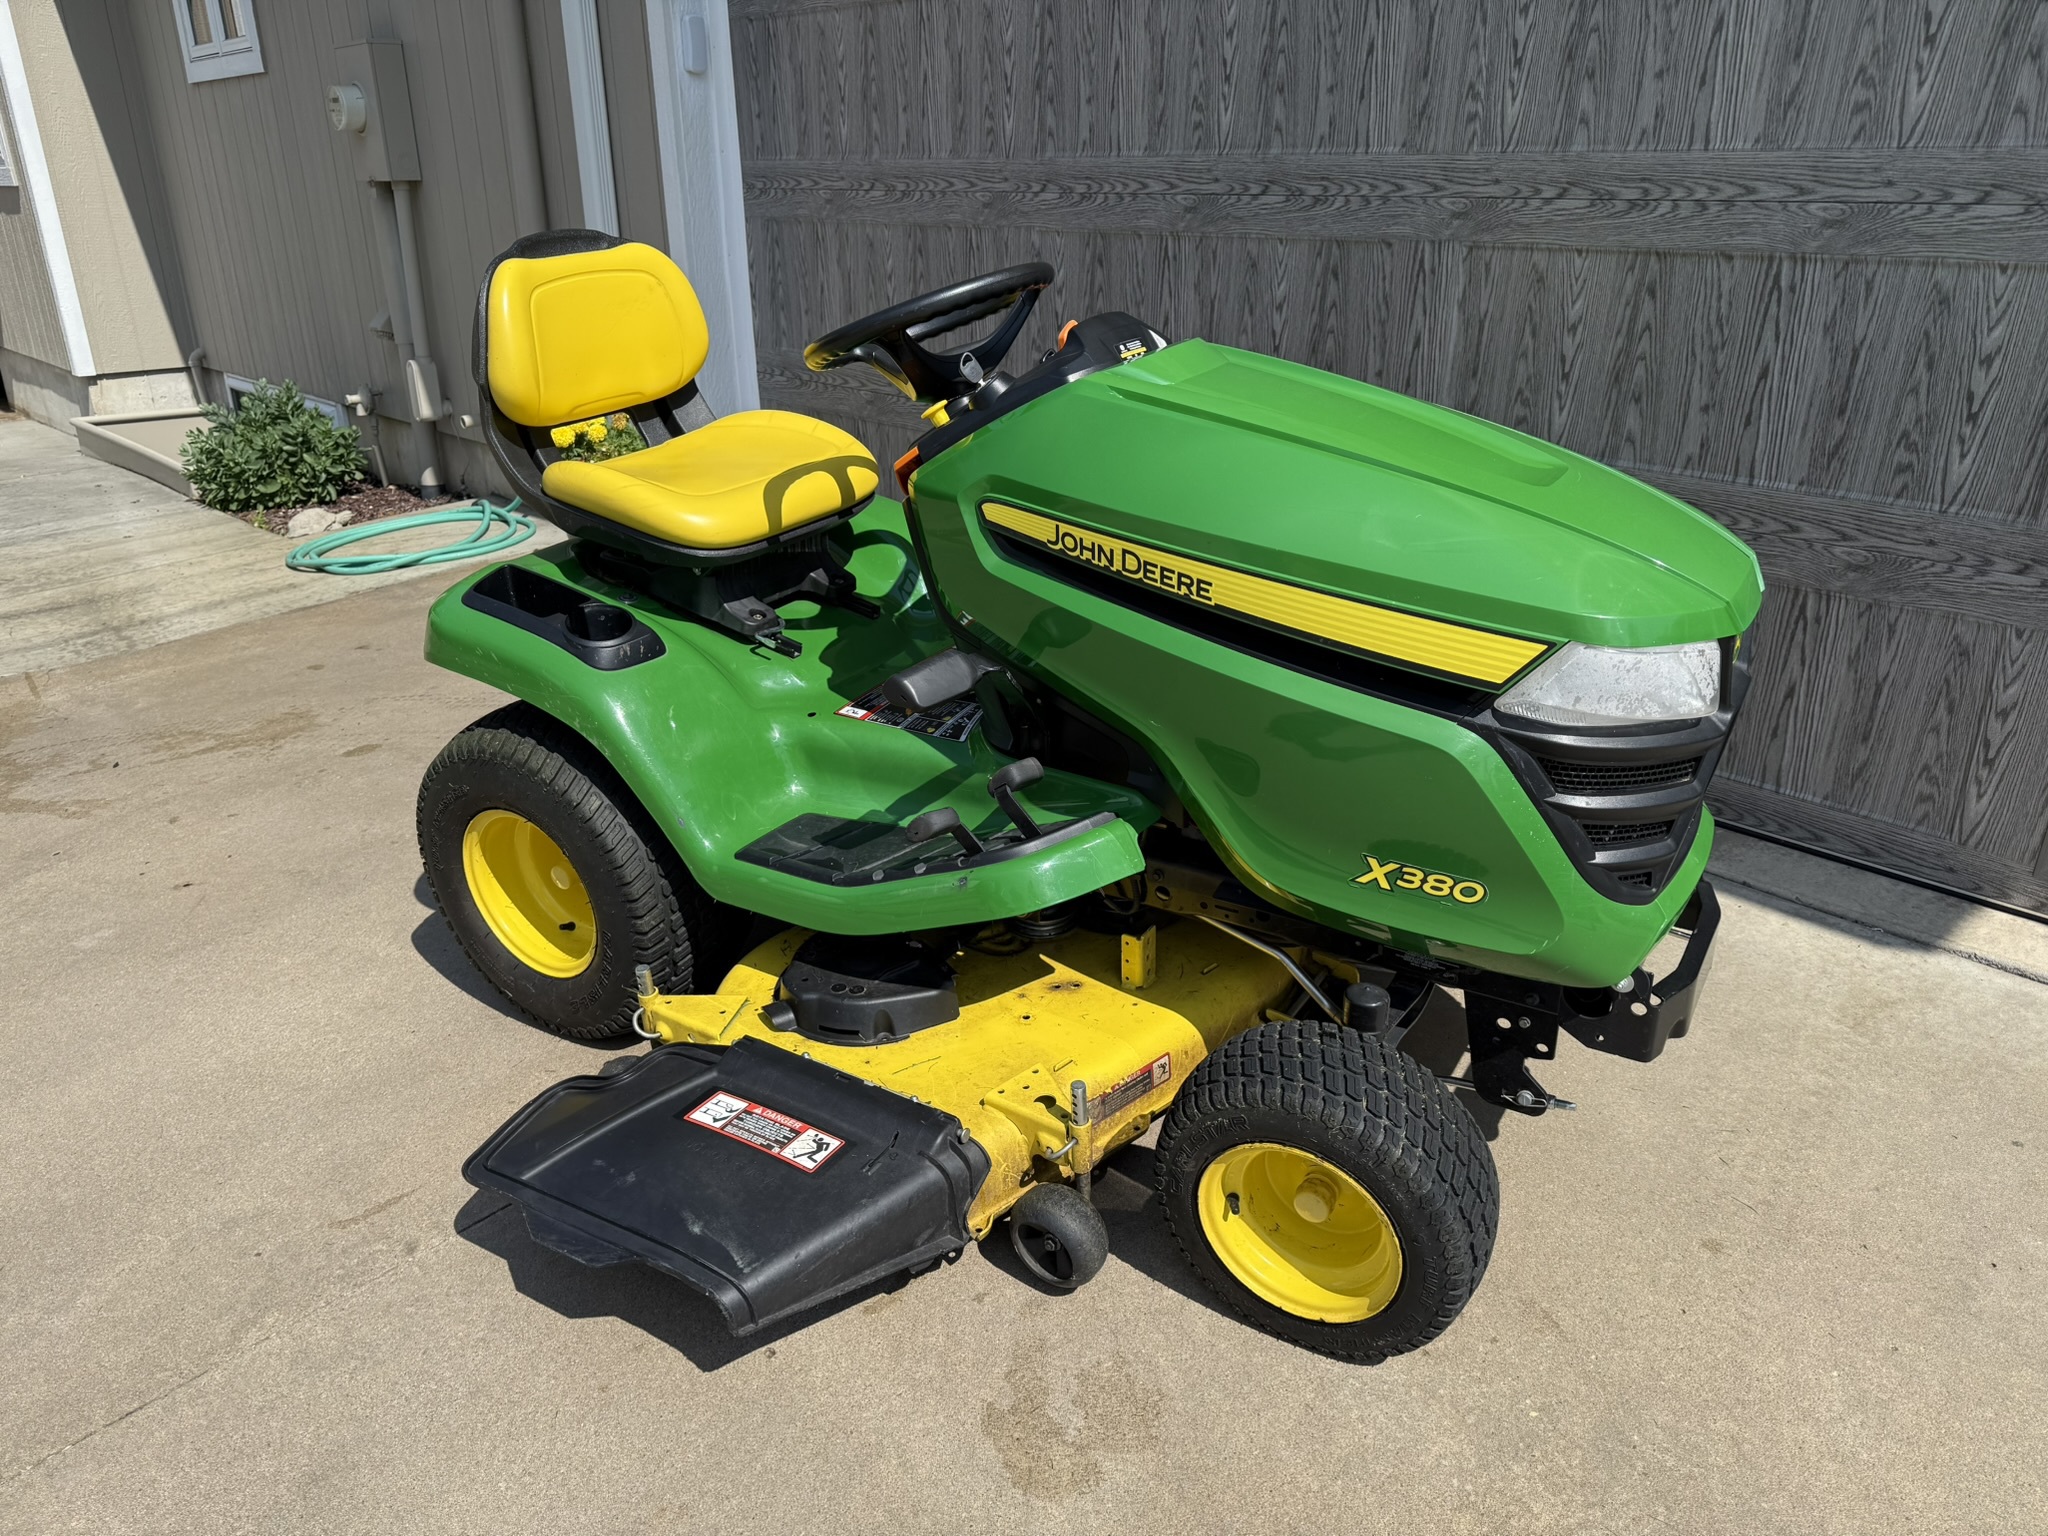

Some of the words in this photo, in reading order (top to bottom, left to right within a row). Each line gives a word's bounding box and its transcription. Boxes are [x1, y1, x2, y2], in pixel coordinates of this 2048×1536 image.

[1046, 523, 1115, 569] JOHN
[1121, 547, 1214, 603] DEERE
[1354, 856, 1486, 904] X380
[763, 1109, 802, 1129] DANGER
[1170, 1113, 1251, 1195] CARLSTAR
[1418, 1254, 1439, 1310] TURF
